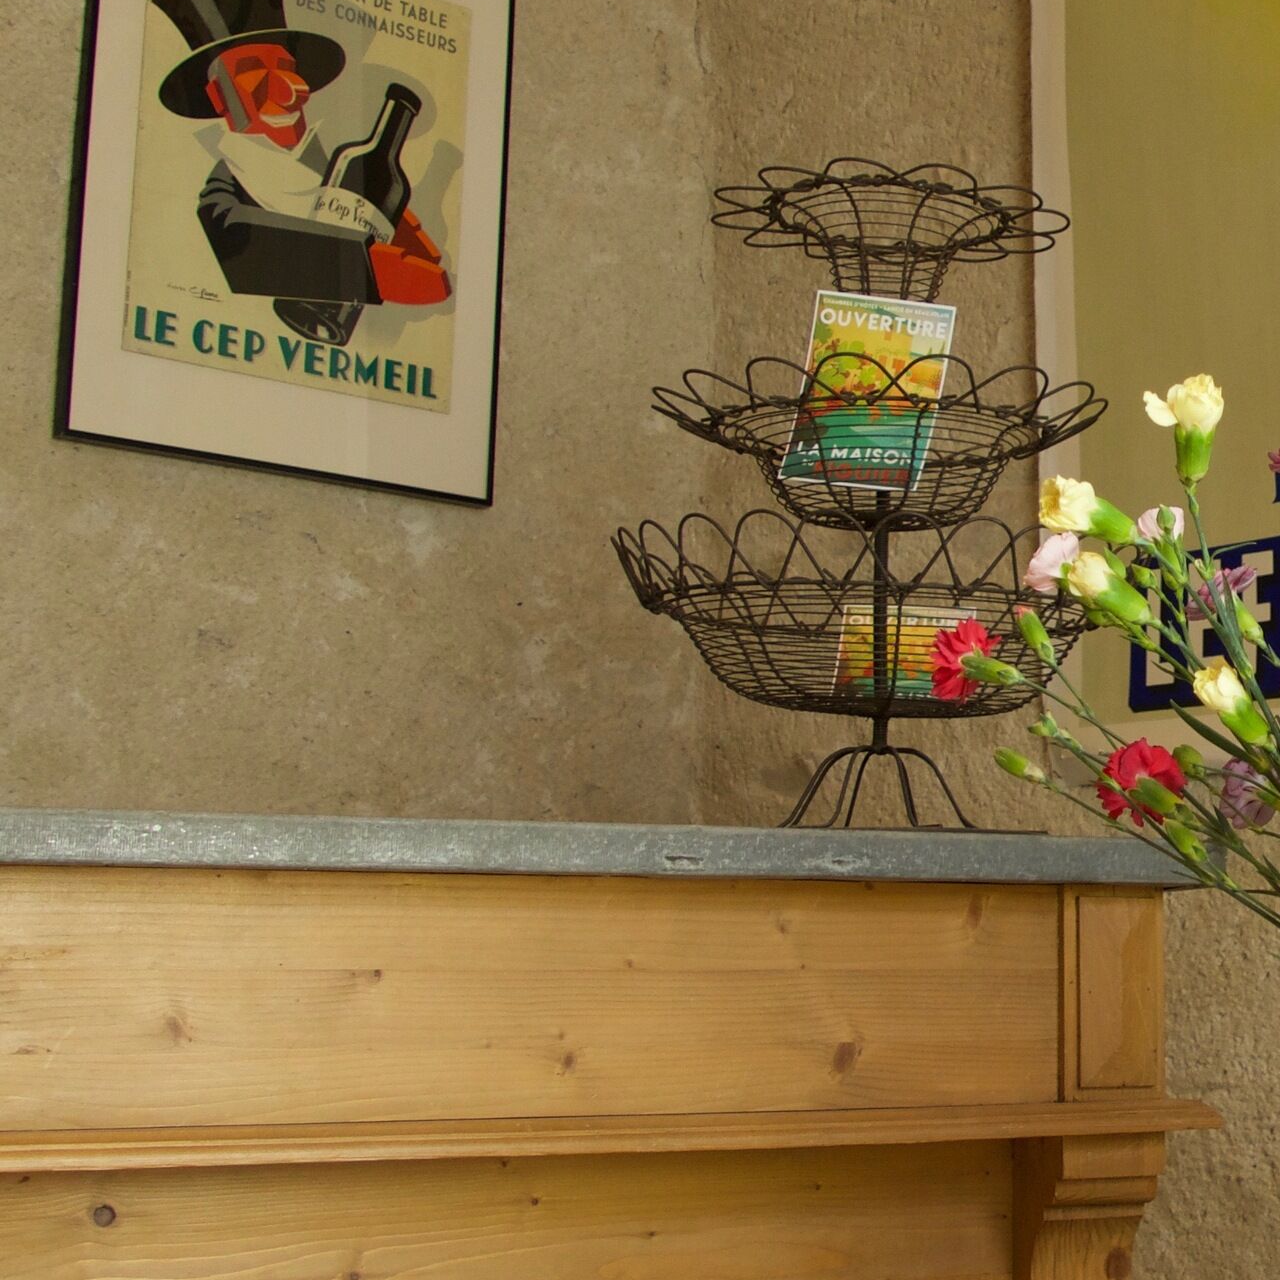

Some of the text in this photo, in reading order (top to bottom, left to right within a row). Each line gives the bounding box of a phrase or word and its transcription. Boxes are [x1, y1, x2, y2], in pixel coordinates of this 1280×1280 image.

[335, 4, 457, 54] CONNAISSEURS
[400, 0, 448, 29] TABLE
[820, 308, 948, 339] OUVERTURE
[134, 305, 438, 400] LE CEP VERMEIL
